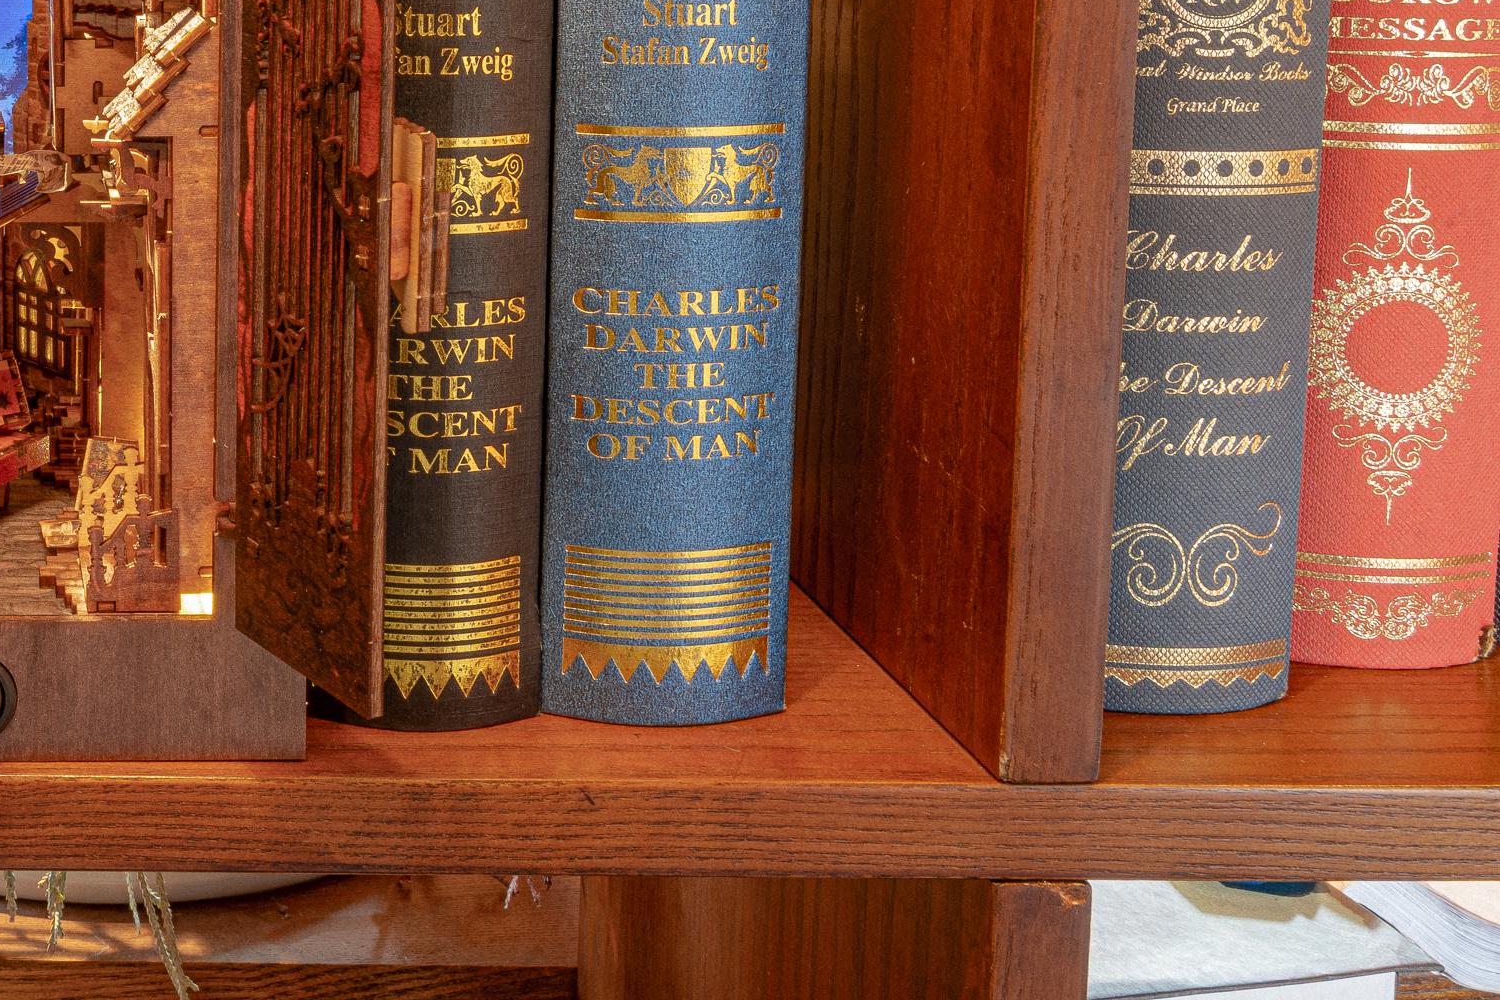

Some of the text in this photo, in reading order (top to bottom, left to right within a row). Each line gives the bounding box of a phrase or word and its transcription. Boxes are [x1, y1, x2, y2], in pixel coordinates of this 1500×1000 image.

[440, 47, 515, 81] Zweig
[601, 35, 769, 71] Stafan Zweig
[1259, 60, 1313, 83] Books
[1166, 96, 1261, 116] Grand Place
[1126, 230, 1284, 272] Charles
[572, 284, 780, 317] CHARLES
[1122, 298, 1269, 334] Darwin
[389, 333, 516, 366] RWIN
[582, 322, 768, 354] DARWIN
[388, 374, 473, 401] THE
[633, 361, 726, 391] THE
[1163, 359, 1293, 395] Descent
[570, 391, 776, 427] DESCENT
[587, 428, 761, 462] OF MAN
[1164, 417, 1271, 457] Man
[408, 443, 510, 475] MAN
